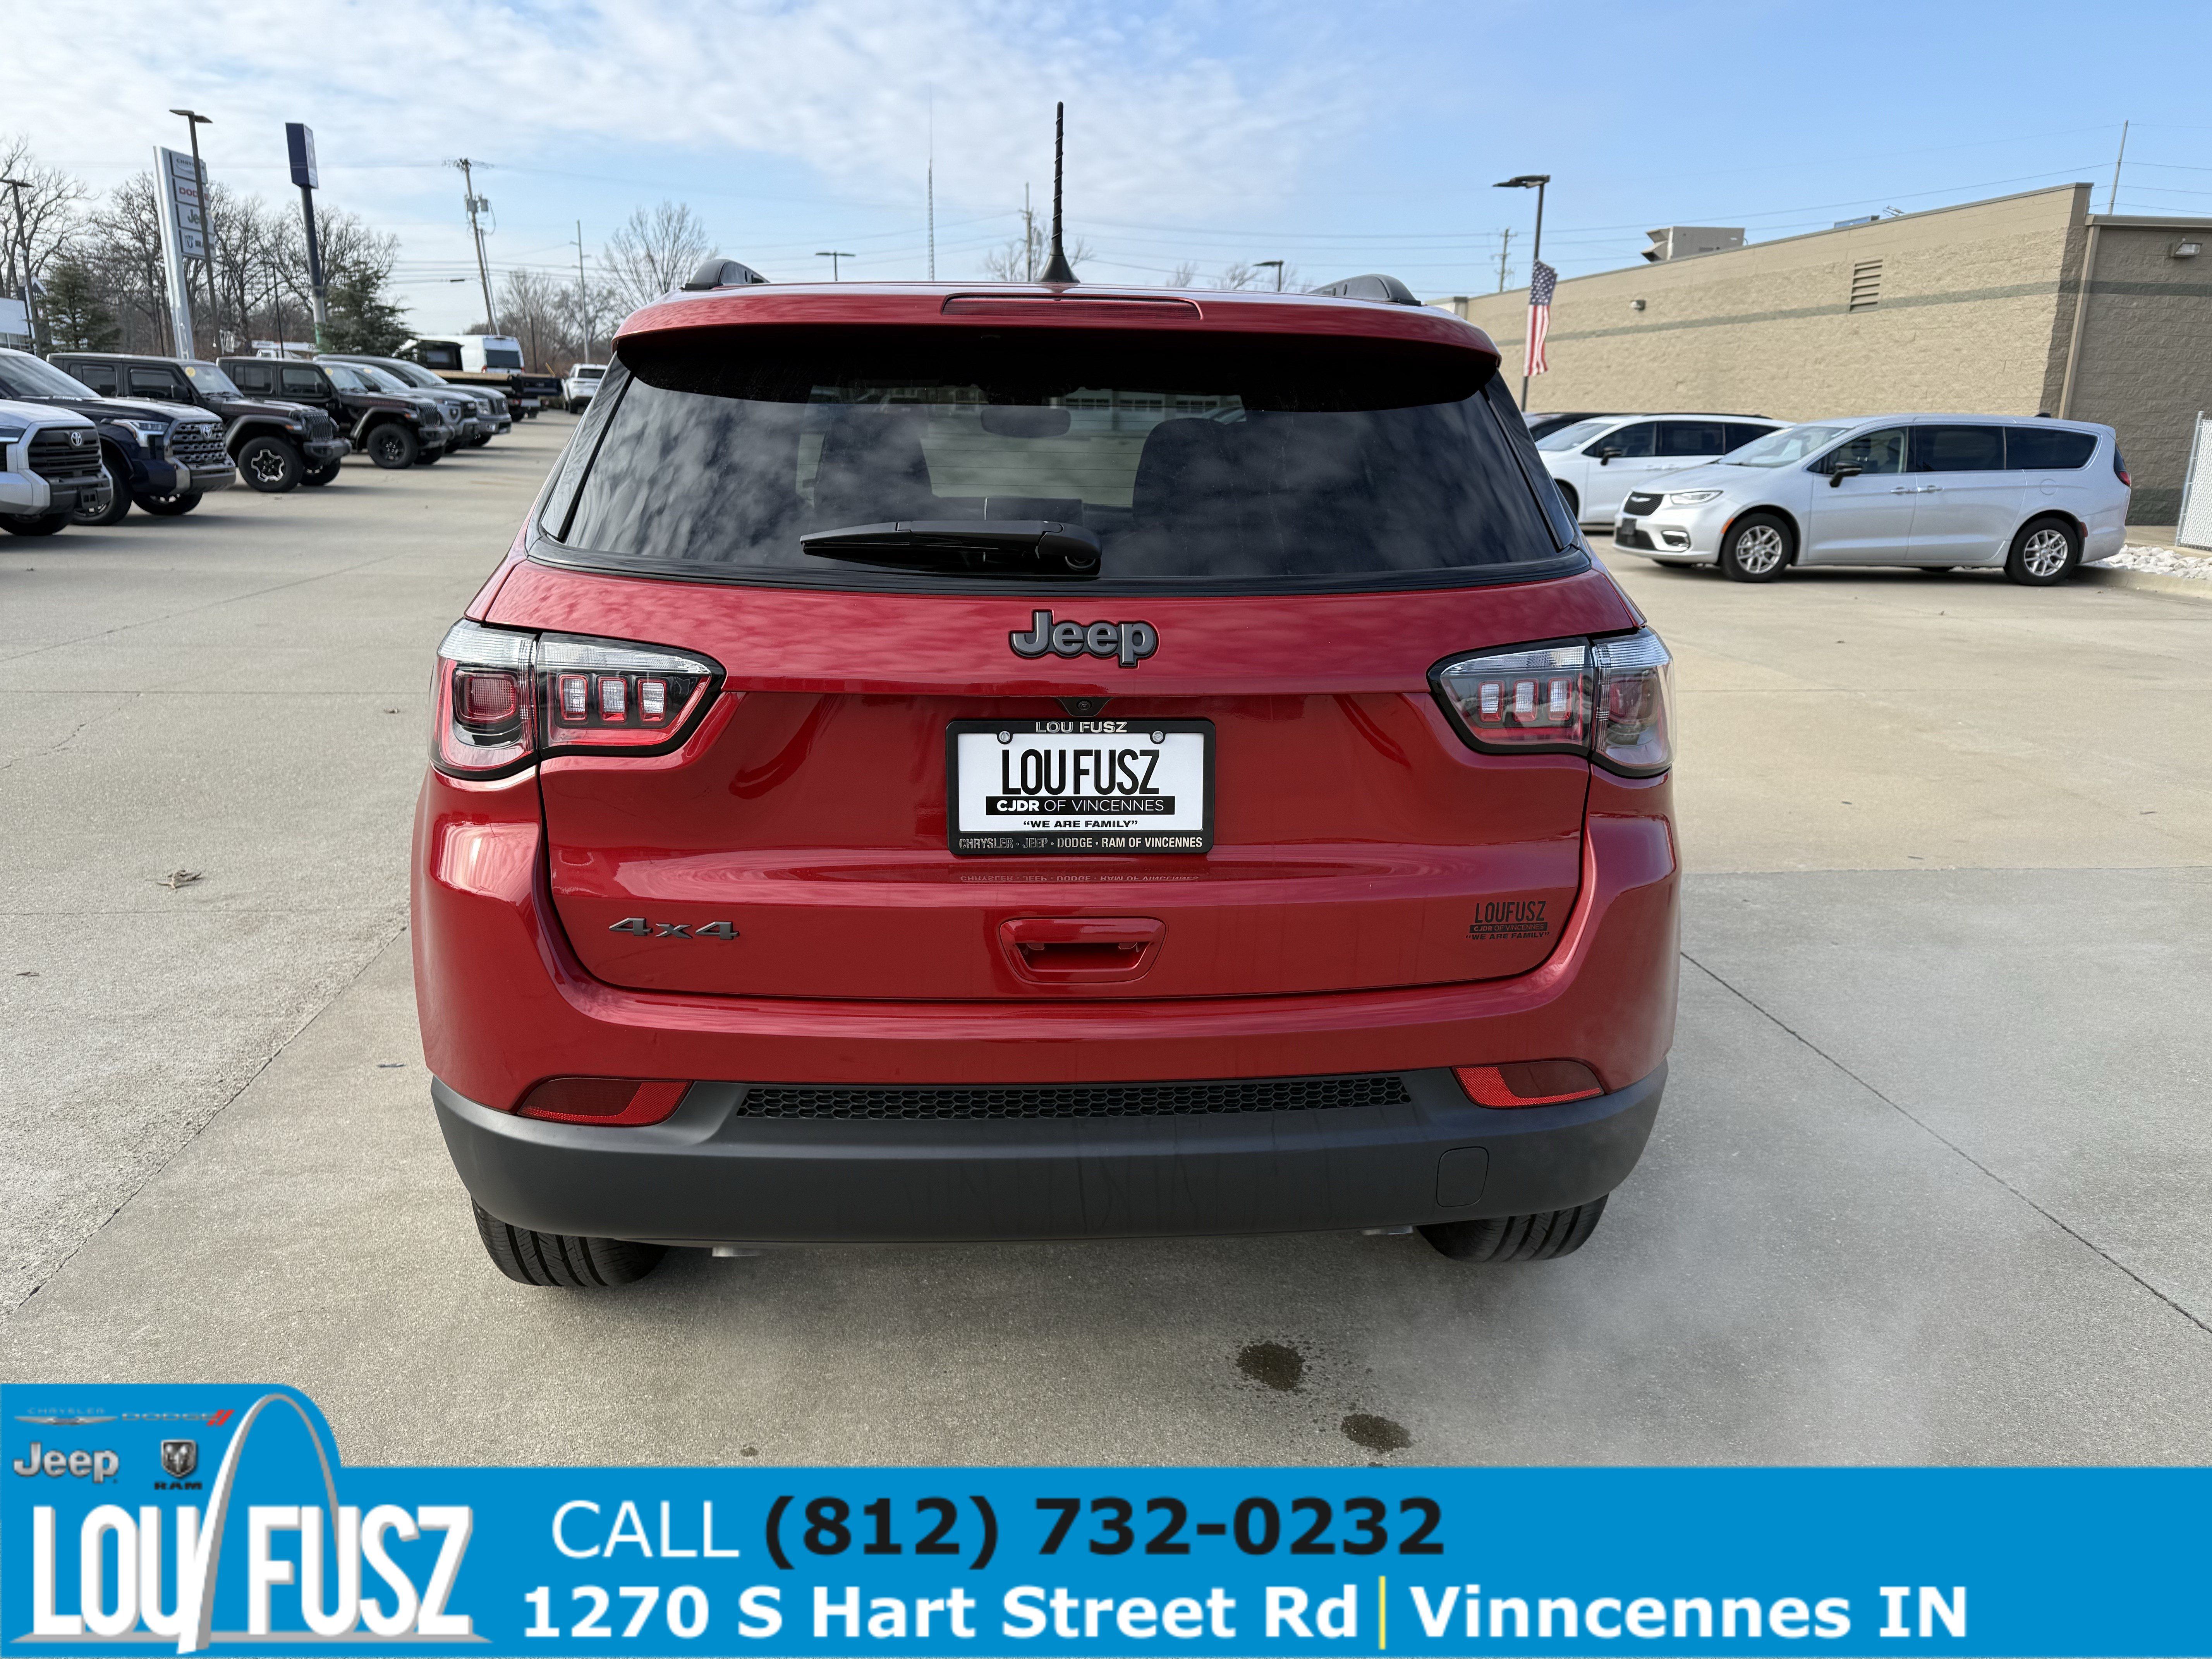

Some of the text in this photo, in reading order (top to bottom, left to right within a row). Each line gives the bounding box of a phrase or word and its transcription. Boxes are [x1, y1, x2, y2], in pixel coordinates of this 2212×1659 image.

[1010, 611, 1157, 667] Jeep
[1036, 721, 1127, 733] LOU FUSZ
[1002, 749, 1159, 795] LOU FUSZ
[996, 800, 1164, 812] CJDR OF VINCENNES
[959, 836, 1202, 849] CHRYSLER JEEP DODGE RAM OF VINCENNES
[608, 916, 740, 941] 4x4
